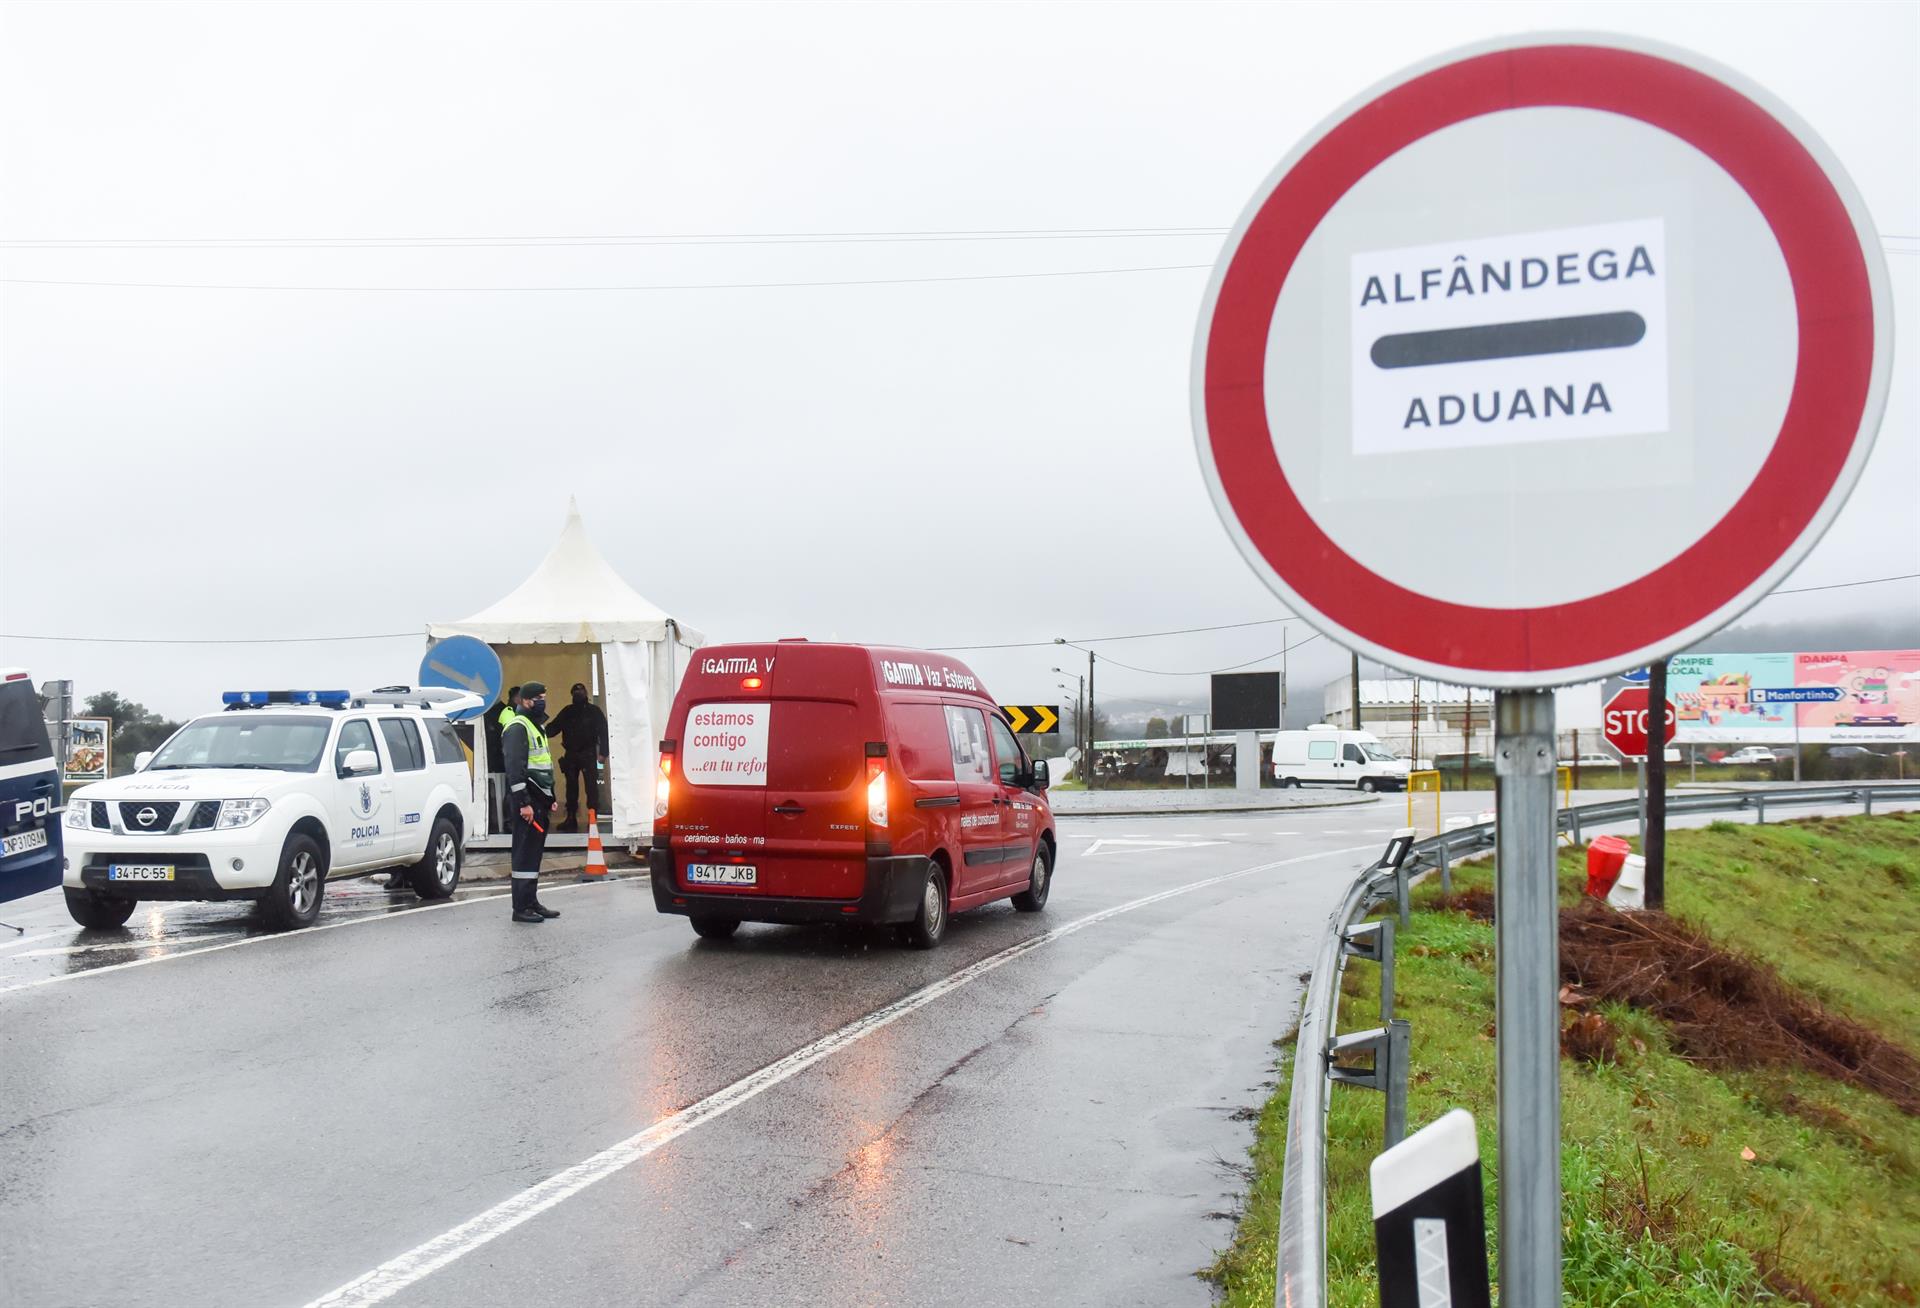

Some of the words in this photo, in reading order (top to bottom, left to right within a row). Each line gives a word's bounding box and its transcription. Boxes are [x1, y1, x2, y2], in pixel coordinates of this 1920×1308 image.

[1360, 245, 1656, 307] ALFÂNDEGA
[1403, 381, 1613, 430] ADUANA
[1672, 657, 1713, 666] OMPRE
[1799, 655, 1849, 664] IDANHA
[923, 664, 942, 687] Vaz
[942, 666, 977, 692] Estevez
[1767, 690, 1836, 700] Monfortinho
[695, 711, 754, 726] estamos
[693, 731, 747, 751] contigo
[720, 758, 734, 773] tu
[684, 833, 720, 844] cerámicas
[725, 833, 747, 845] baños
[752, 836, 765, 845] ma
[696, 866, 726, 880] 9417
[730, 867, 754, 881] JKB
